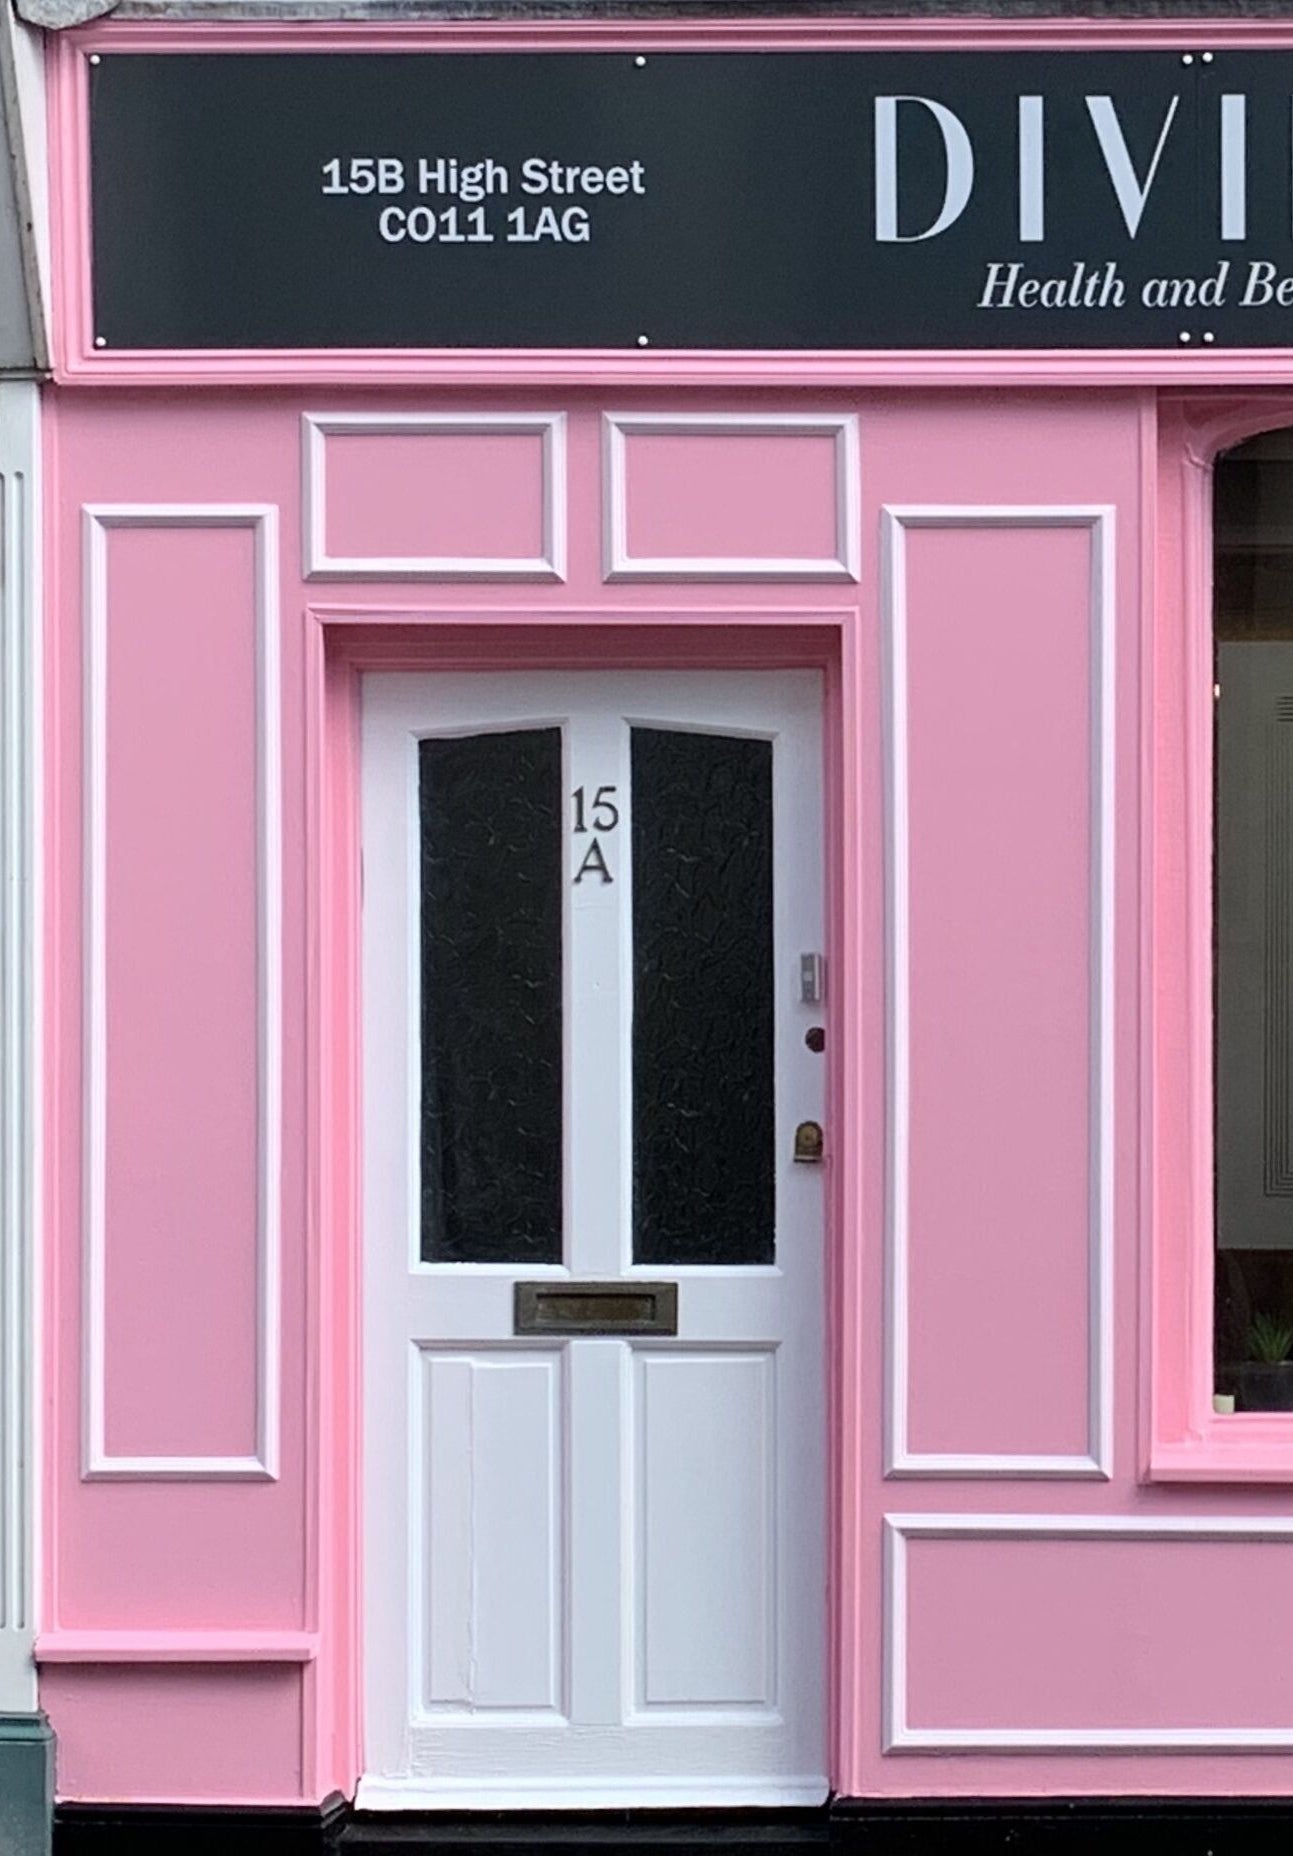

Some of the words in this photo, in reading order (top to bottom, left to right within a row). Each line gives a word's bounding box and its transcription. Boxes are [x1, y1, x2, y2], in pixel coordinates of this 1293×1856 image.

[322, 158, 405, 194] 15B
[418, 158, 508, 202] High
[521, 158, 646, 194] Street
[507, 206, 590, 242] 1AG
[977, 263, 1125, 308] Health
[1142, 261, 1230, 308] and
[571, 785, 619, 834] 15
[573, 837, 614, 884] A
